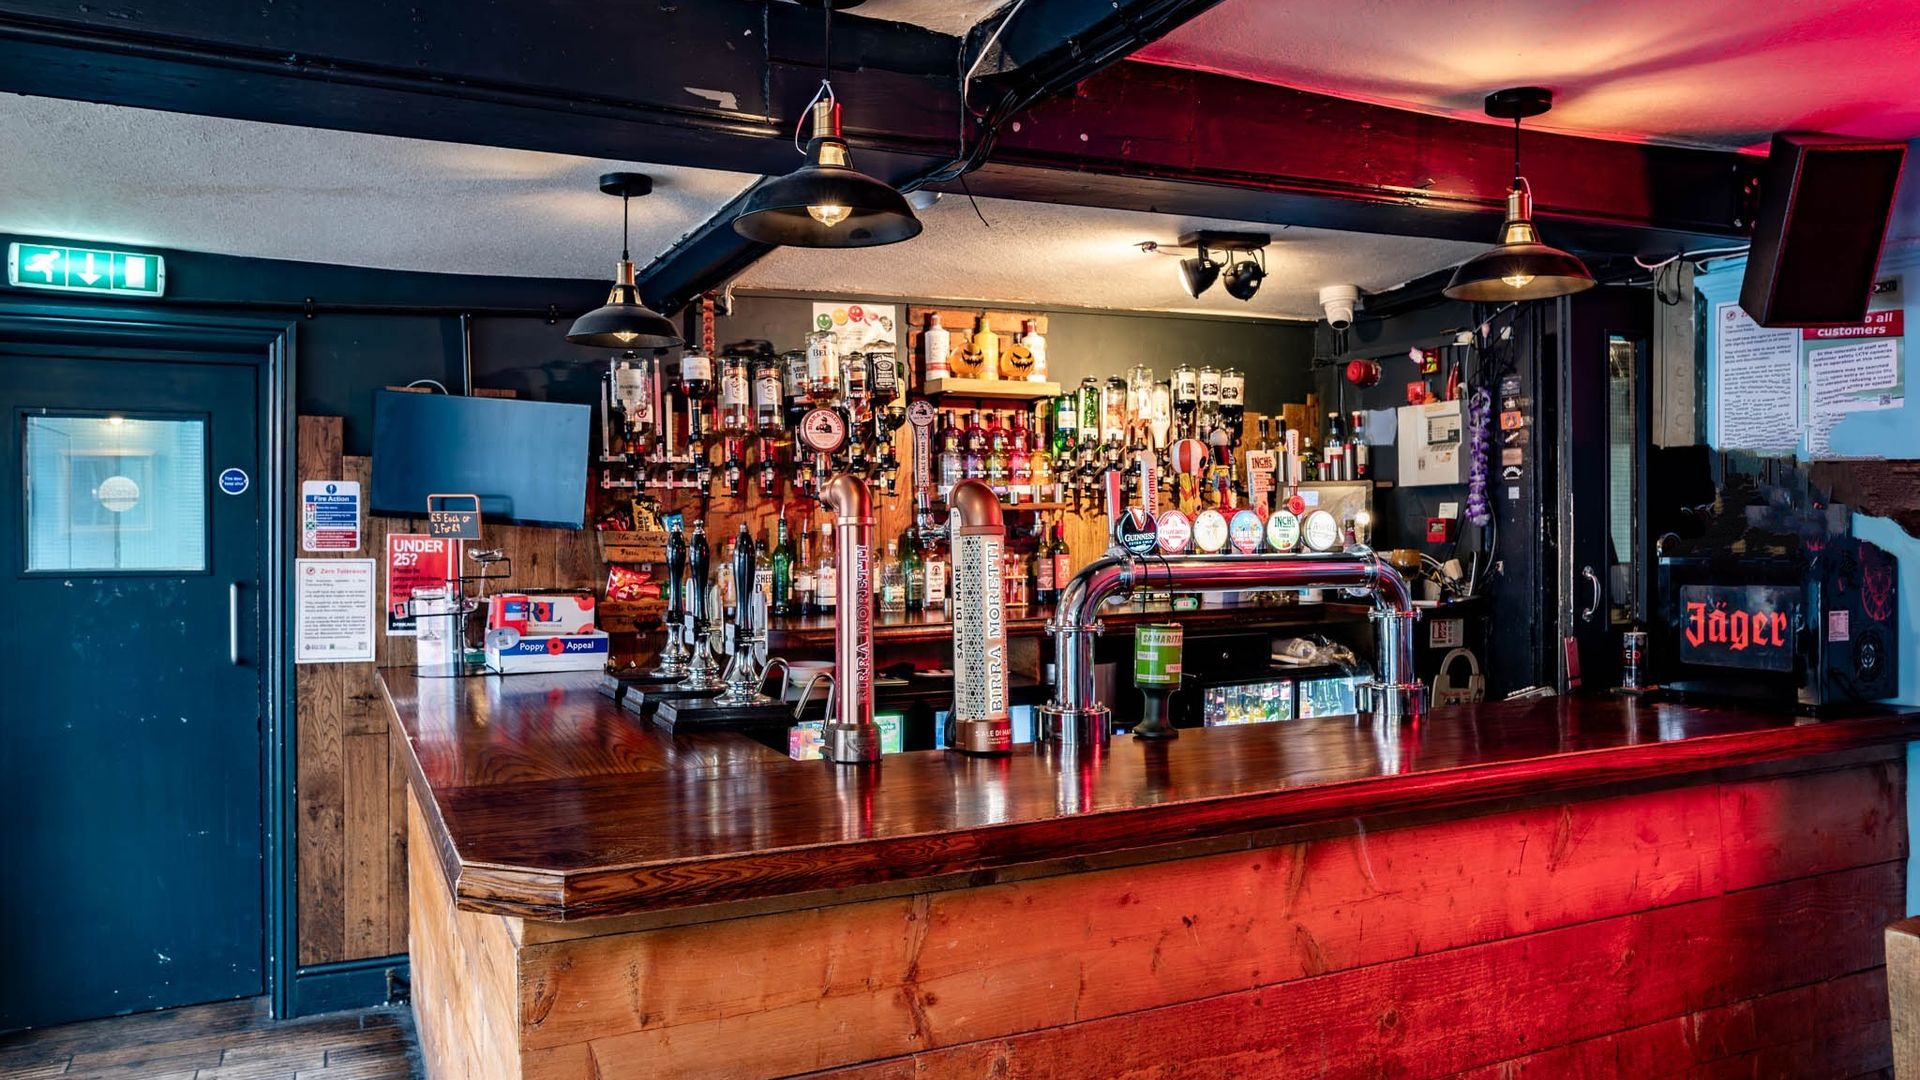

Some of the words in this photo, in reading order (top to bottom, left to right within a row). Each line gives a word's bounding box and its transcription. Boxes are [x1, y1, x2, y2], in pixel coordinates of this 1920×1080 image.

[1876, 312, 1893, 322] all
[1817, 326, 1886, 337] customers
[808, 413, 820, 430] BIRRA
[821, 411, 841, 431] MORETTI
[1147, 467, 1158, 517] ruzcampo
[393, 540, 443, 553] UNDER
[1125, 532, 1155, 542] GUINNESS
[393, 553, 418, 566] 25?
[755, 573, 772, 583] SHEE
[954, 565, 962, 601] MARE
[856, 544, 870, 636] MORETTI
[987, 542, 1001, 637] MORETTI
[955, 607, 963, 620] DI
[1685, 601, 1788, 650] Jäger
[520, 642, 544, 651] Poppy
[566, 640, 594, 650] Appeal
[956, 626, 964, 659] SALE
[856, 642, 870, 704] BIRRA
[989, 646, 1002, 712] BIRRA
